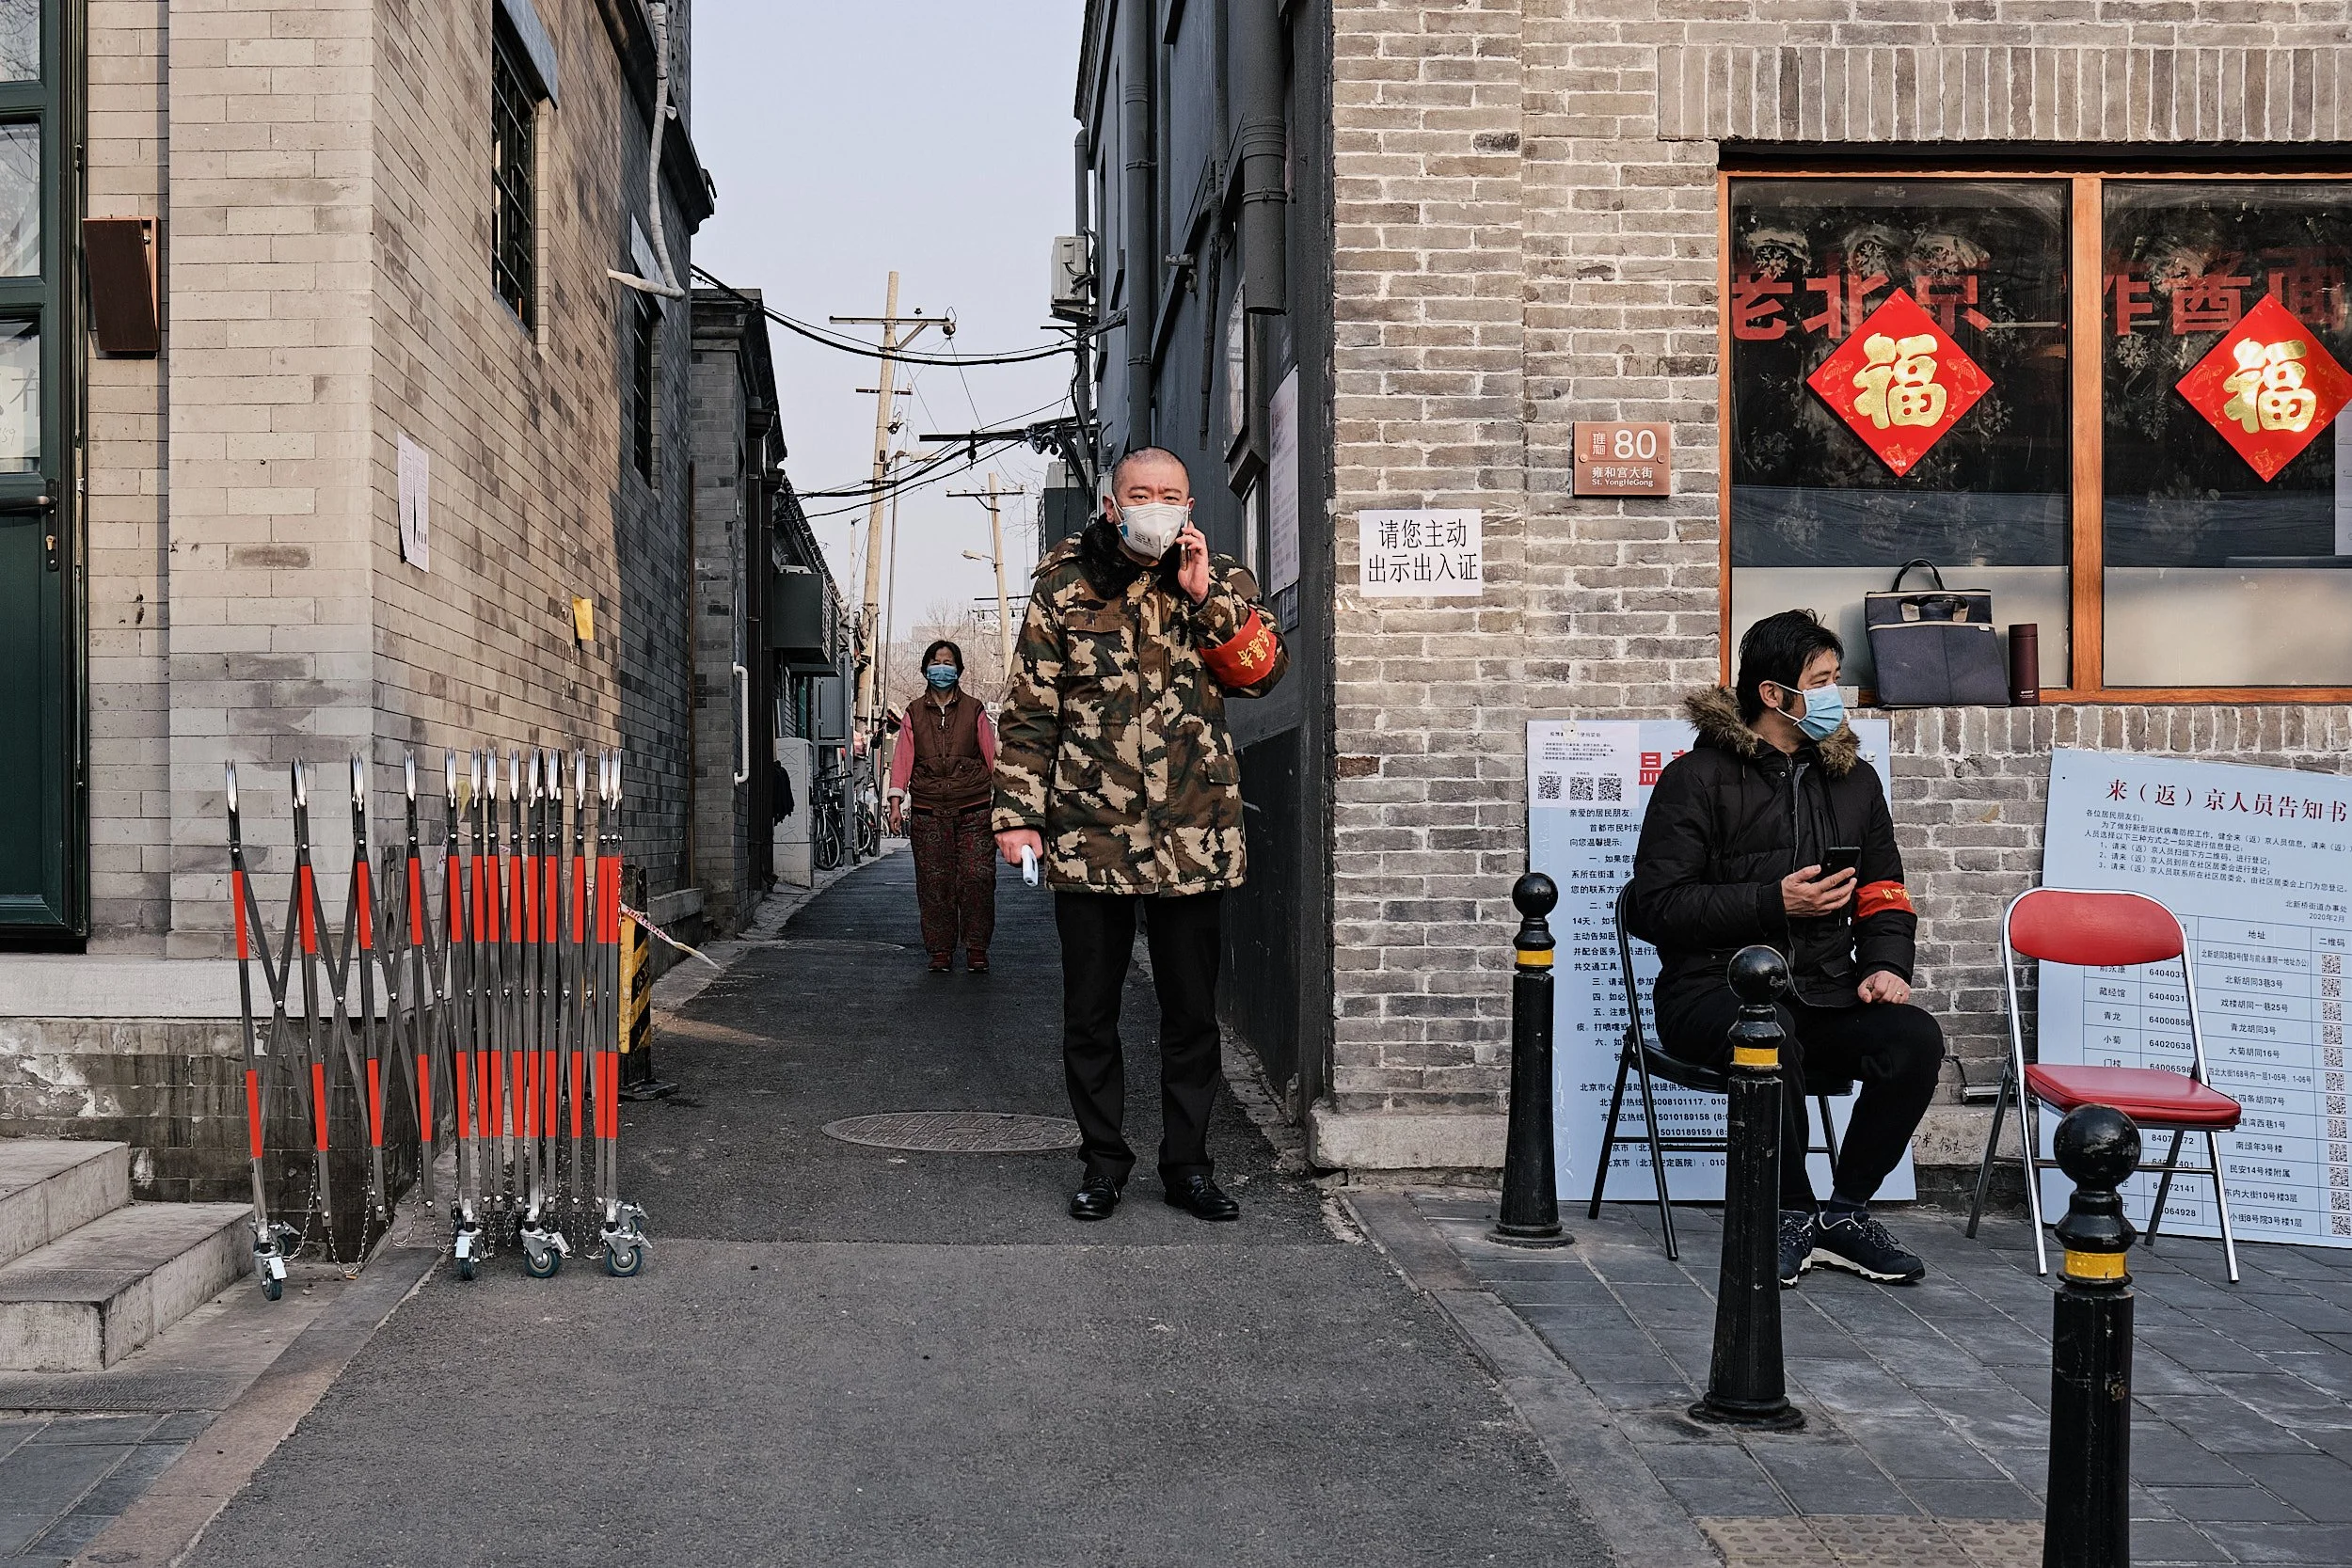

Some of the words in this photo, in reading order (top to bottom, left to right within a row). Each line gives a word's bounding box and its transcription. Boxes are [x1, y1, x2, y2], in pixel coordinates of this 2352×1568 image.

[1852, 333, 1947, 429] 福
[2223, 337, 2316, 434] 福
[1614, 429, 1657, 459] 80
[1592, 467, 1653, 479] 雍和宫大街
[1605, 479, 1653, 487] YongHeGong
[1378, 518, 1468, 549] 请您主动
[1368, 553, 1478, 583] 出示出入证
[2106, 779, 2347, 822] 来（返）京人员告知书
[1571, 870, 1634, 879] 系所在街道（乡
[1589, 901, 1616, 910] 二、请
[2309, 912, 2345, 923] 2020年2月
[2248, 929, 2265, 940] 地址
[2319, 938, 2345, 947] 二维码
[2149, 969, 2185, 978] 6404031
[1593, 992, 1652, 1001] 四、如必参加
[2149, 992, 2185, 1003] 6404031
[2104, 1011, 2122, 1022] 青龙
[2231, 1022, 2277, 1035] 青龙胡同3号
[2149, 1039, 2191, 1050] 64020638
[2229, 1047, 2280, 1058] 大菊胡同16号
[2239, 1117, 2285, 1130] 道湾西巷1号
[2152, 1134, 2194, 1145] 840772
[2164, 1207, 2196, 1216] 064928
[2230, 1213, 2302, 1227] 小街8号院3号楼1层
